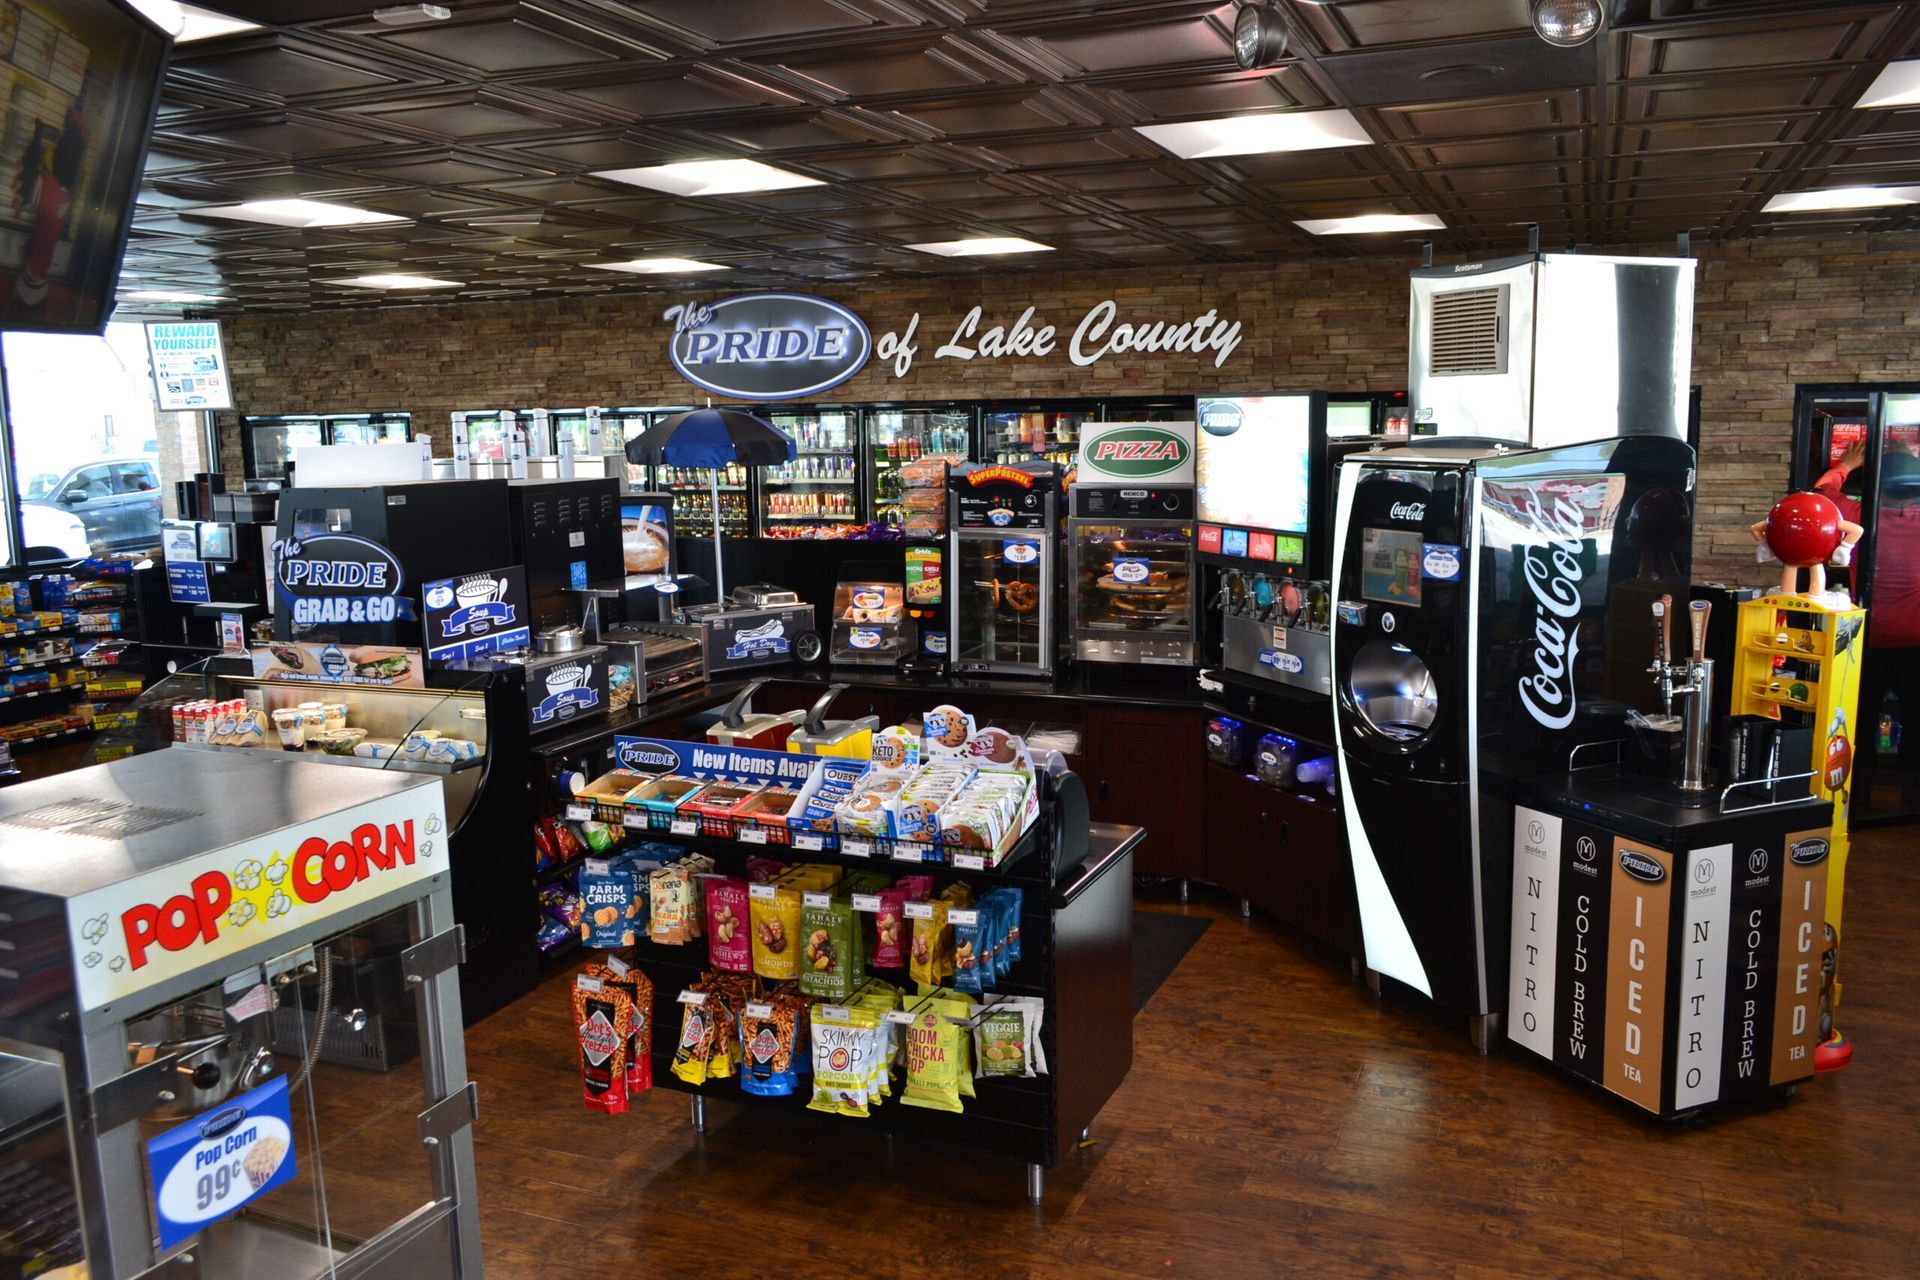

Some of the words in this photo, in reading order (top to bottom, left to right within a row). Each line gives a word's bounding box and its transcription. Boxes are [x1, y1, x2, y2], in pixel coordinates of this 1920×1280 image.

[1454, 262, 1483, 272] Scotsman
[664, 301, 712, 333] The
[154, 325, 216, 338] REWARD
[935, 305, 1056, 360] Lake
[1068, 300, 1242, 368] County
[154, 338, 217, 350] YOURSELF!
[683, 324, 848, 365] PRIDE
[877, 312, 920, 378] of
[1094, 440, 1180, 461] PIZZA
[271, 537, 301, 560] The
[286, 560, 387, 588] PRIDE
[468, 606, 489, 620] Soup
[1518, 485, 1585, 730] Coca-Cola
[556, 693, 575, 706] Soup
[618, 741, 633, 751] The
[872, 744, 894, 757] KETO
[624, 750, 676, 766] PRIDE
[692, 748, 725, 769] New
[729, 752, 775, 775] Items
[828, 769, 857, 782] QUEST
[1524, 845, 1547, 857] modest
[1572, 861, 1598, 874] modest
[1622, 856, 1660, 876] PRIDE
[589, 884, 624, 895] PARM
[1745, 875, 1770, 887] modest
[120, 870, 233, 971] POP
[292, 818, 416, 904] CORN
[586, 893, 627, 905] CRISPS
[713, 889, 745, 901] SAHALE
[1690, 886, 1717, 897] modest
[806, 912, 843, 924] SAHALE
[596, 930, 617, 938] Original
[1574, 895, 1590, 972] COLD
[1523, 876, 1542, 1032] NITRO
[1745, 908, 1762, 990] COLD
[1791, 880, 1812, 1036] ICED
[1625, 895, 1646, 1056] ICED
[1685, 920, 1711, 1089] NITRO
[586, 1018, 612, 1036] Dot's
[984, 1022, 1020, 1033] VEGGIE
[1569, 981, 1586, 1060] BREW
[581, 1037, 617, 1054] Pretzels
[821, 1027, 865, 1046] SKINNY
[906, 1026, 937, 1046] BOOM
[1738, 1000, 1756, 1079] BREW
[818, 1045, 862, 1072] POP
[906, 1041, 945, 1062] CHICKA
[1789, 1046, 1805, 1061] TEA
[906, 1056, 924, 1073] POP
[1622, 1062, 1641, 1084] TEA
[816, 1070, 862, 1080] POPCORN
[203, 1110, 243, 1135] PRIDE
[195, 1144, 222, 1170] Pop
[225, 1126, 257, 1155] Corn
[196, 1160, 241, 1211] 99¢
